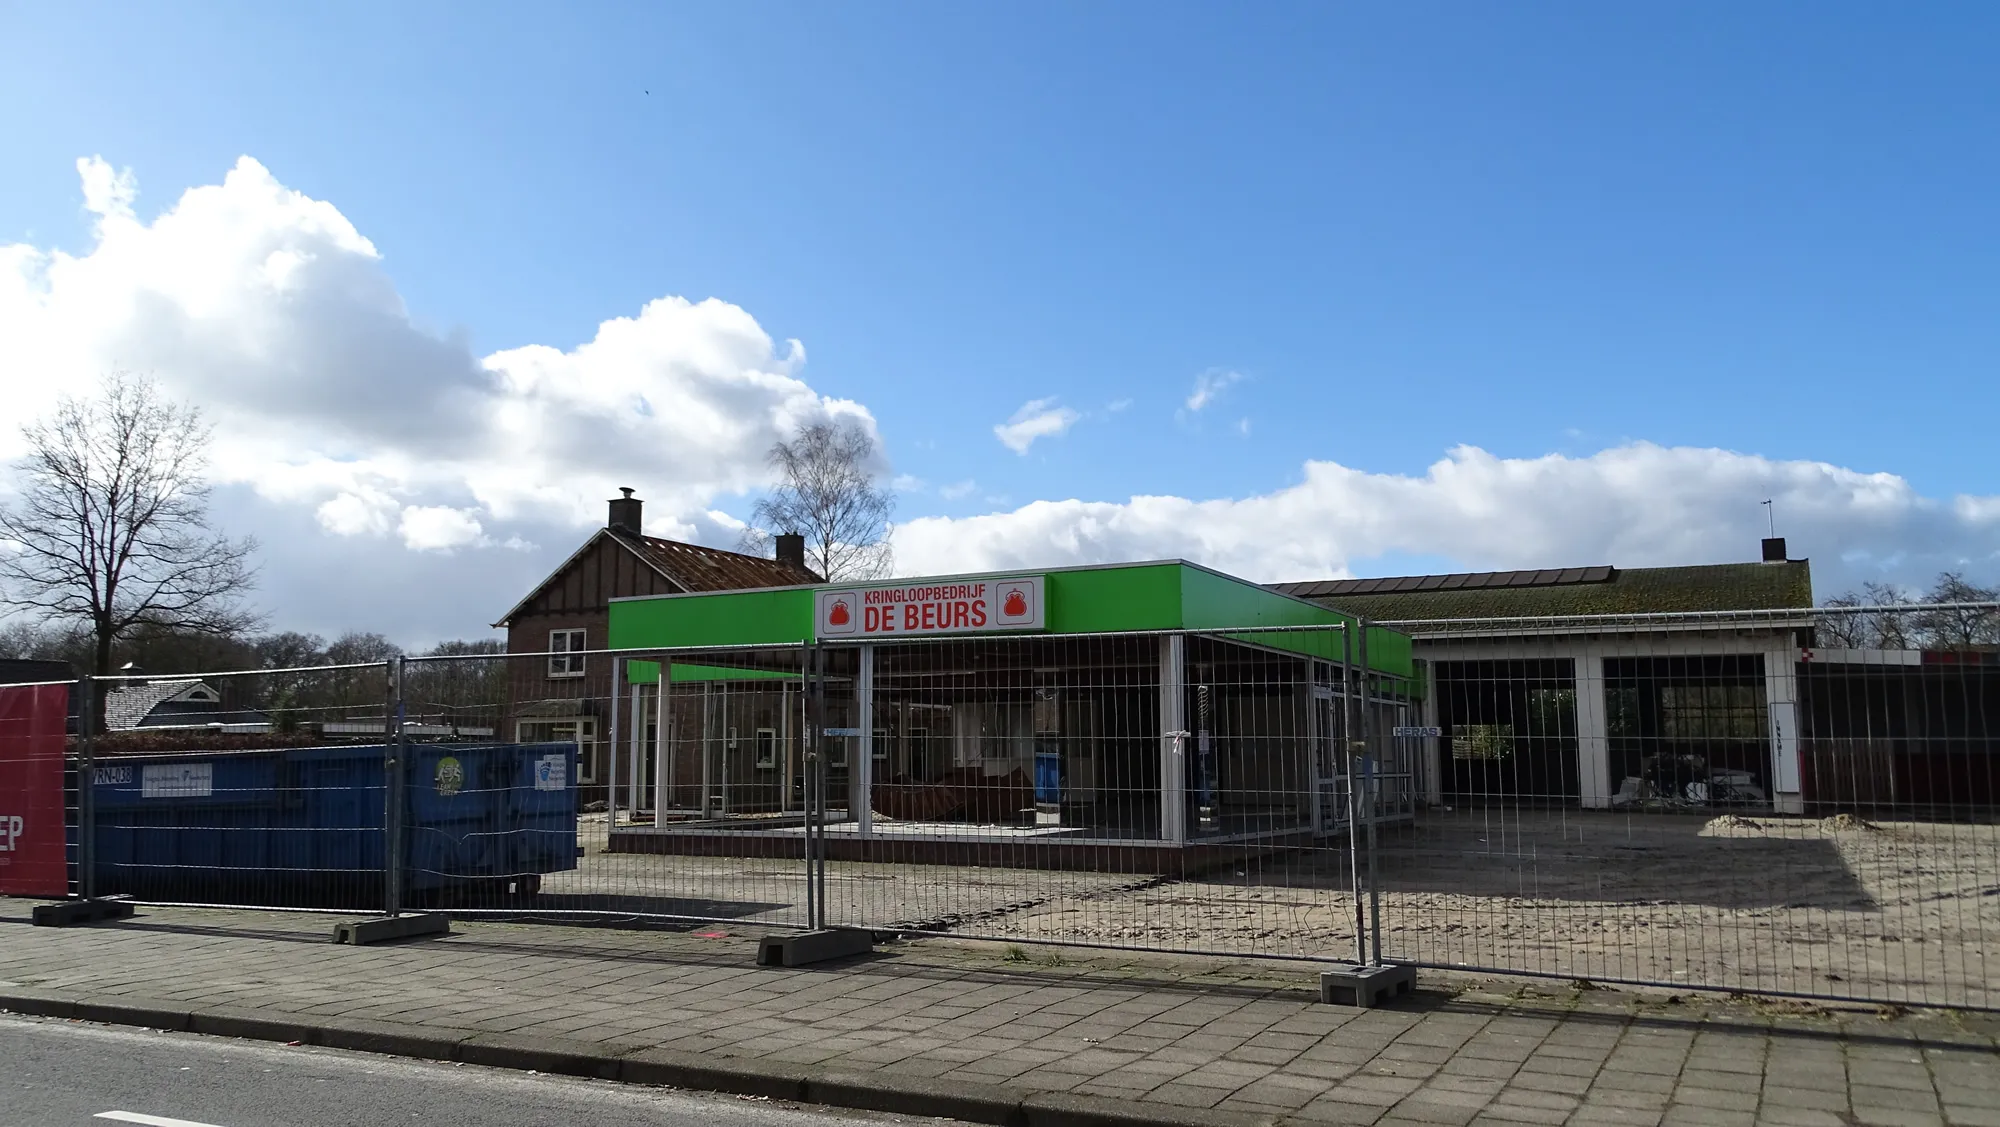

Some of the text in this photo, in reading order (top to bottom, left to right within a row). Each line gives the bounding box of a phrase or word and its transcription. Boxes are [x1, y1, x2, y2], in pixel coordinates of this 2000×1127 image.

[864, 584, 985, 604] KRINGLOOPBEDRIJF
[864, 600, 987, 632] DE BEURS
[1395, 727, 1437, 737] HERAS
